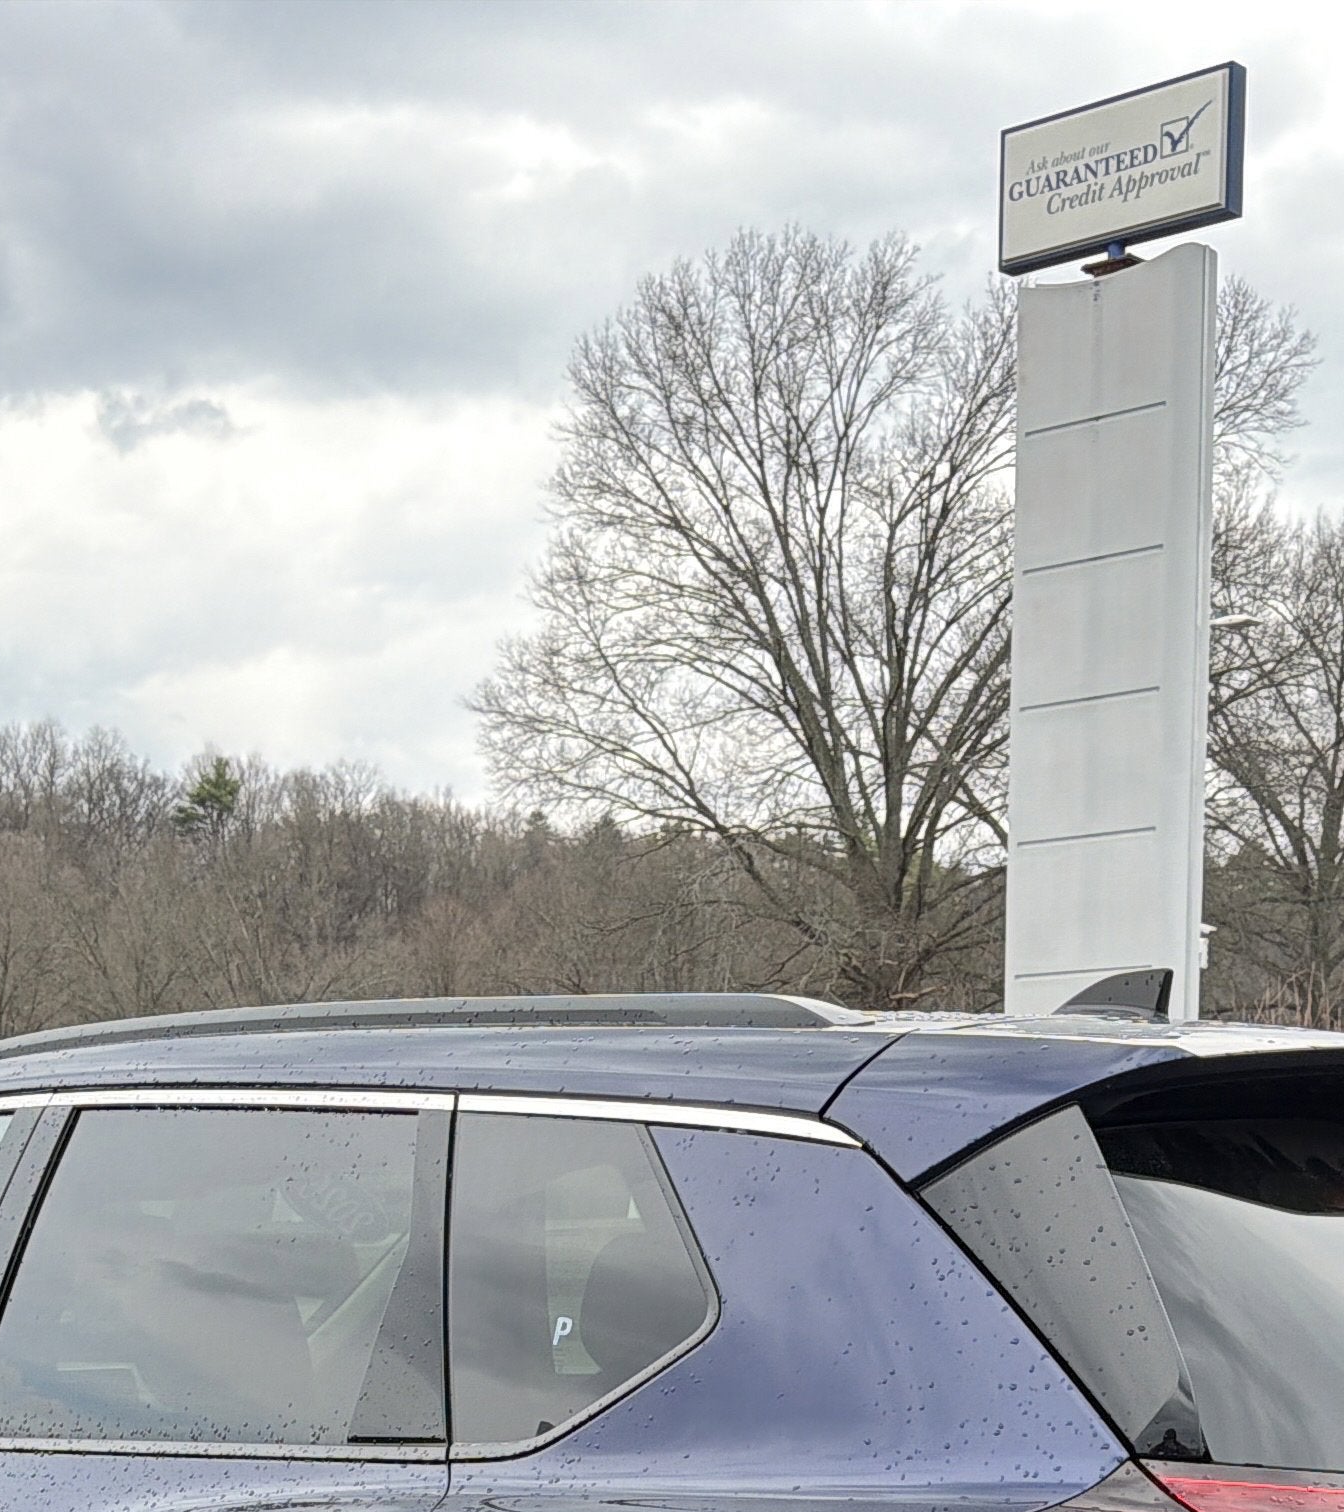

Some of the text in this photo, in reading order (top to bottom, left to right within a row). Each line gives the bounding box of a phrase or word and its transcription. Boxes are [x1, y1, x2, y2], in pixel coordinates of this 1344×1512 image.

[1008, 143, 1158, 202] GUARANTEED
[1026, 141, 1111, 176] Ask about our
[1046, 152, 1201, 215] Credit Approval
